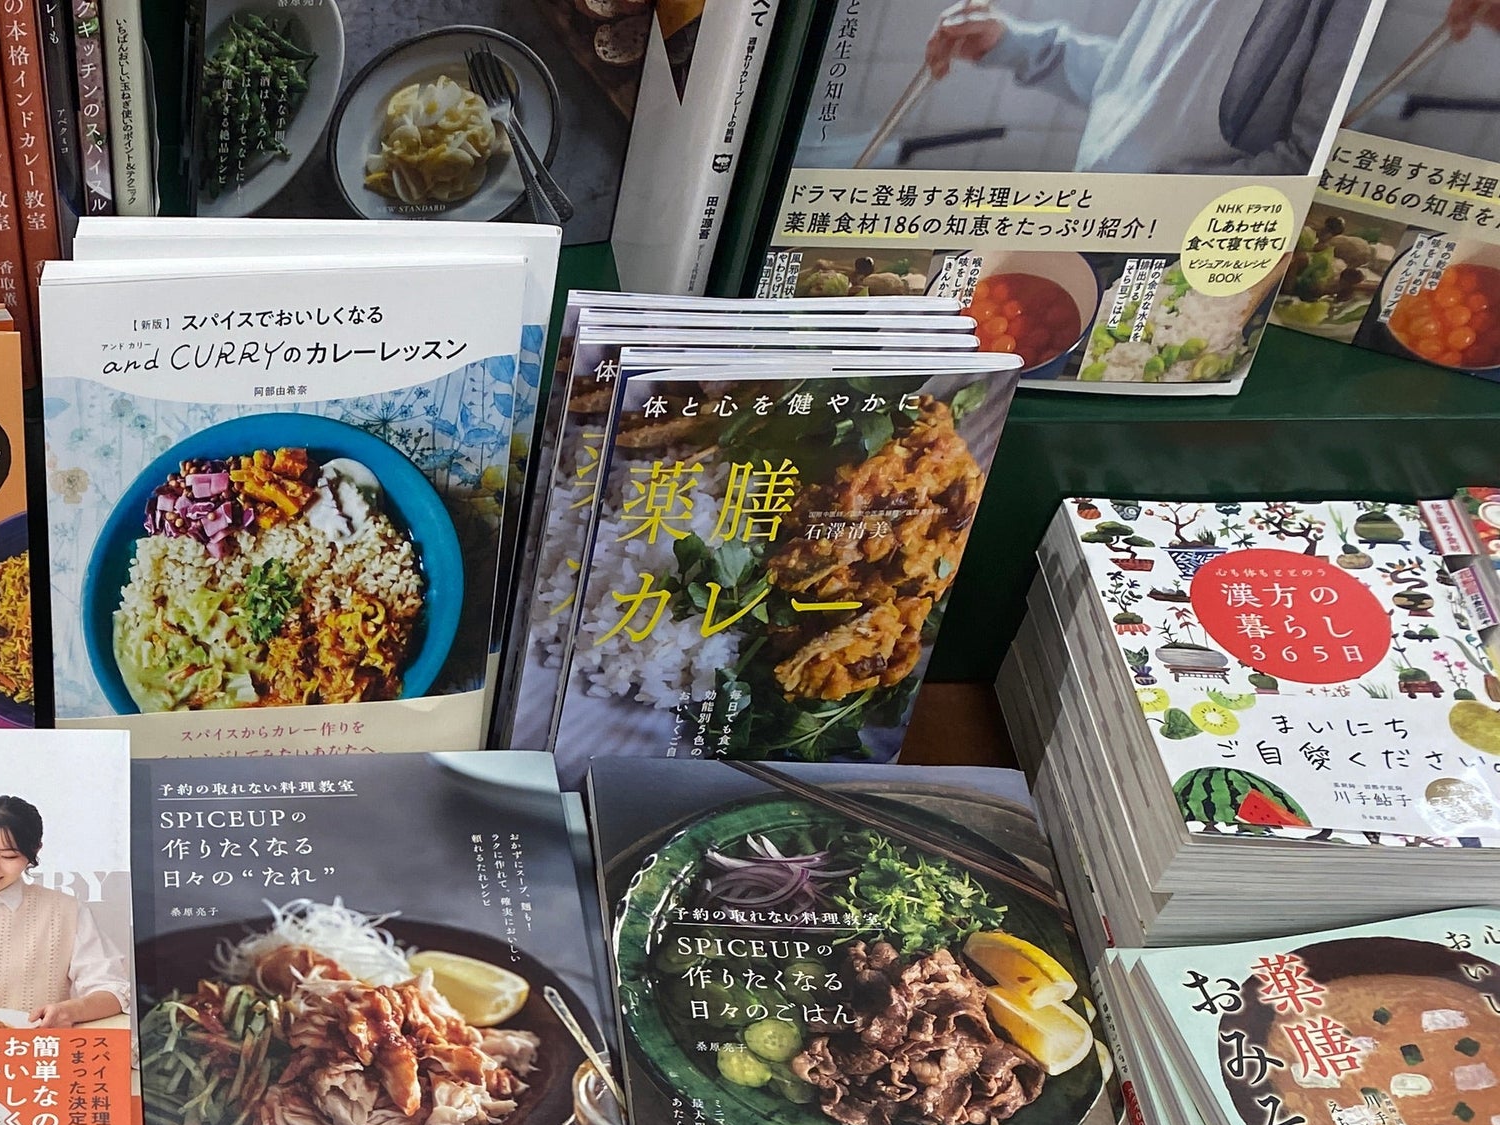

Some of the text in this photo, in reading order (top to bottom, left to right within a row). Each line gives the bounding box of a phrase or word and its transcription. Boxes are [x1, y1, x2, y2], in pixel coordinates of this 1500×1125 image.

[790, 183, 1093, 212] ドラマに登場する料理レシピと
[1216, 203, 1282, 214] NHK ドラマ10
[783, 211, 1159, 241] 薬膳食材186の知恵をたっぷり紹介!
[1186, 235, 1287, 252] 食べて寝て待て」
[1207, 272, 1242, 284] BOOK
[181, 305, 384, 332] スパイスでおいしくなる
[642, 392, 922, 421] 体と心を健やかに
[615, 459, 801, 545] 薬膳
[1221, 582, 1340, 609] 漢方の
[593, 573, 864, 647] カレー
[1236, 613, 1353, 640] 暮らし
[1248, 644, 1364, 664] 365日
[181, 719, 367, 743] スパイスからカレー作りを
[1271, 714, 1409, 741] まいにち
[158, 779, 356, 797] 予約の取れない料理教室
[159, 809, 307, 830] SPICEUPの
[162, 836, 315, 861] 作りたくなる
[673, 907, 884, 927] 予約の取れない料理教室
[677, 935, 833, 960] SPICEUPの
[681, 965, 844, 993] 作りたくなる
[689, 999, 857, 1026] 日々のごはん
[1251, 954, 1364, 1078] 薬膳
